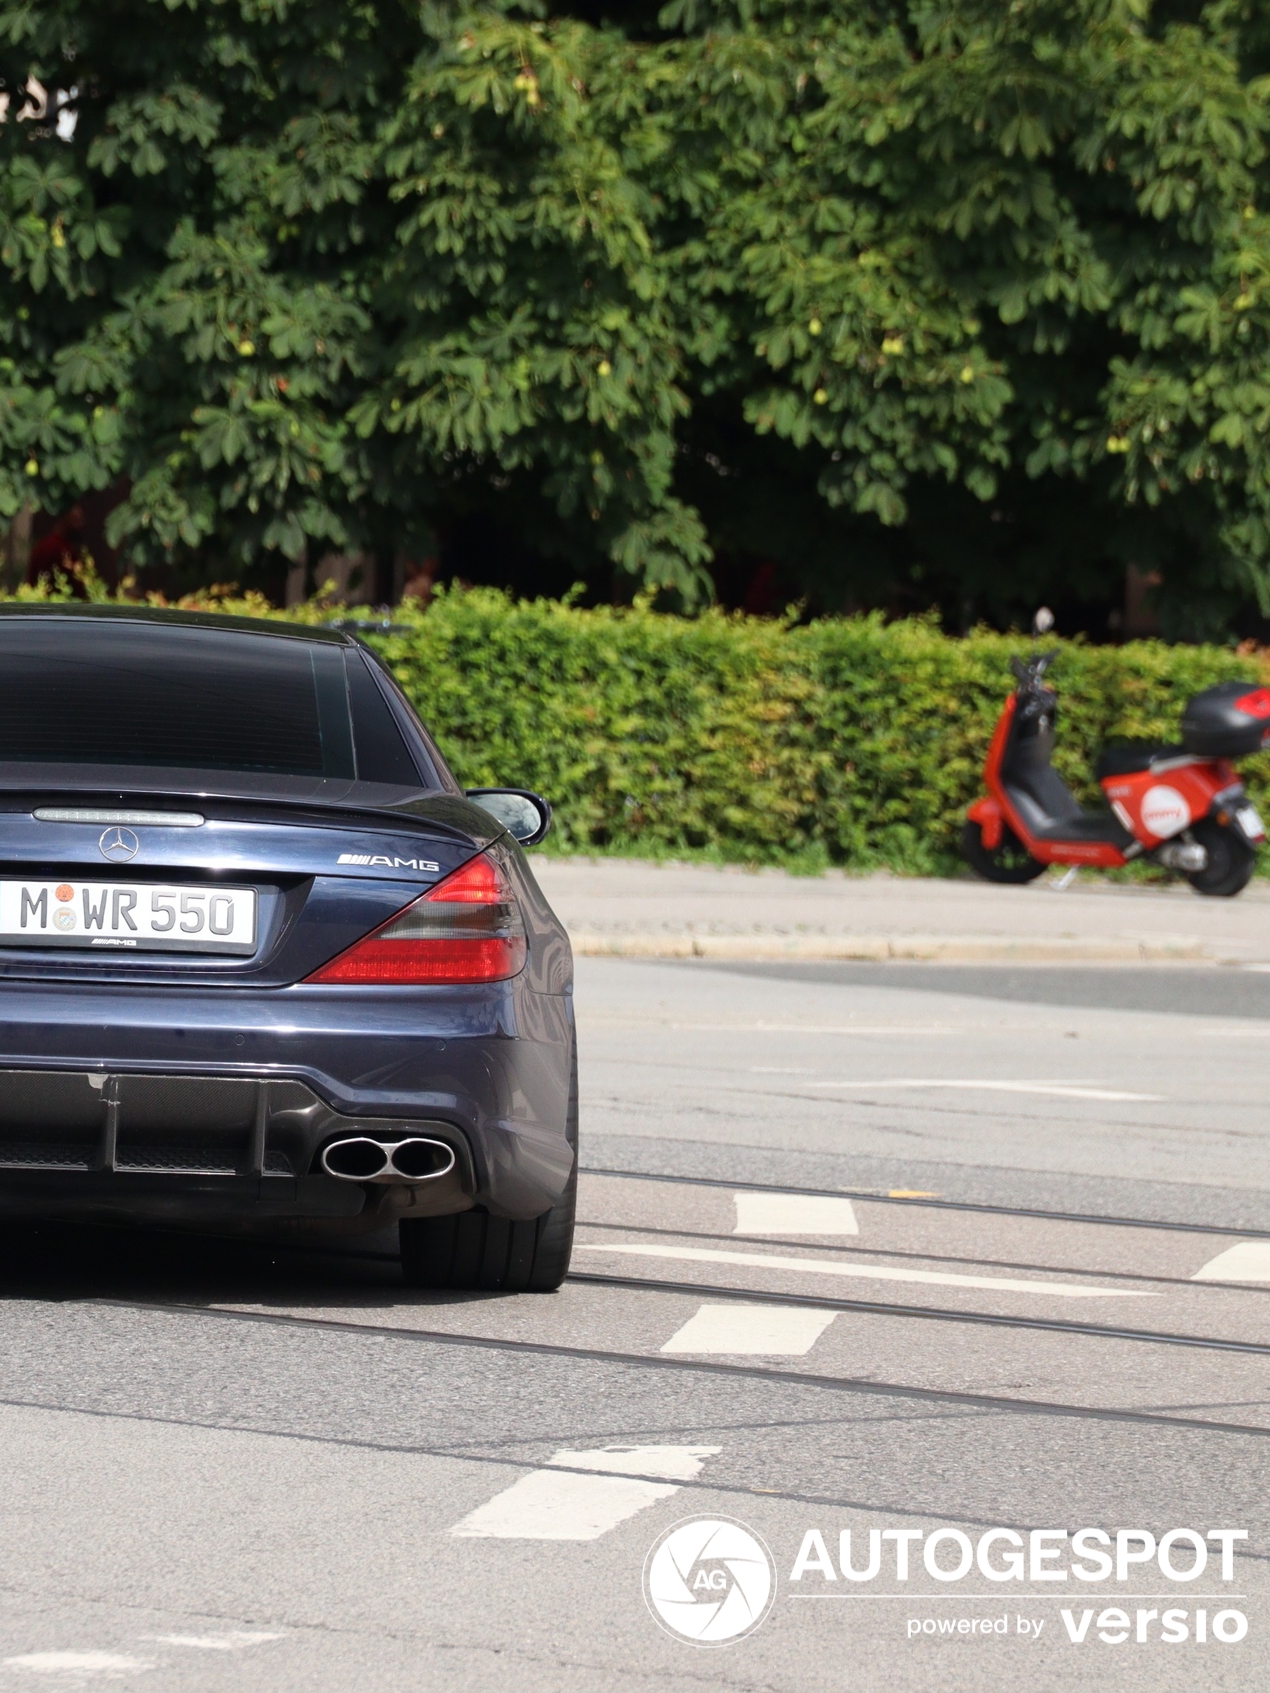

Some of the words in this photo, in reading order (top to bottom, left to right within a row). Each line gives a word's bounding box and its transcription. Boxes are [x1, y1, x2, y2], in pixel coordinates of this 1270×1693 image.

[369, 855, 440, 872] AMG
[20, 887, 48, 928] M
[82, 888, 138, 931] WR
[150, 890, 235, 936] 550
